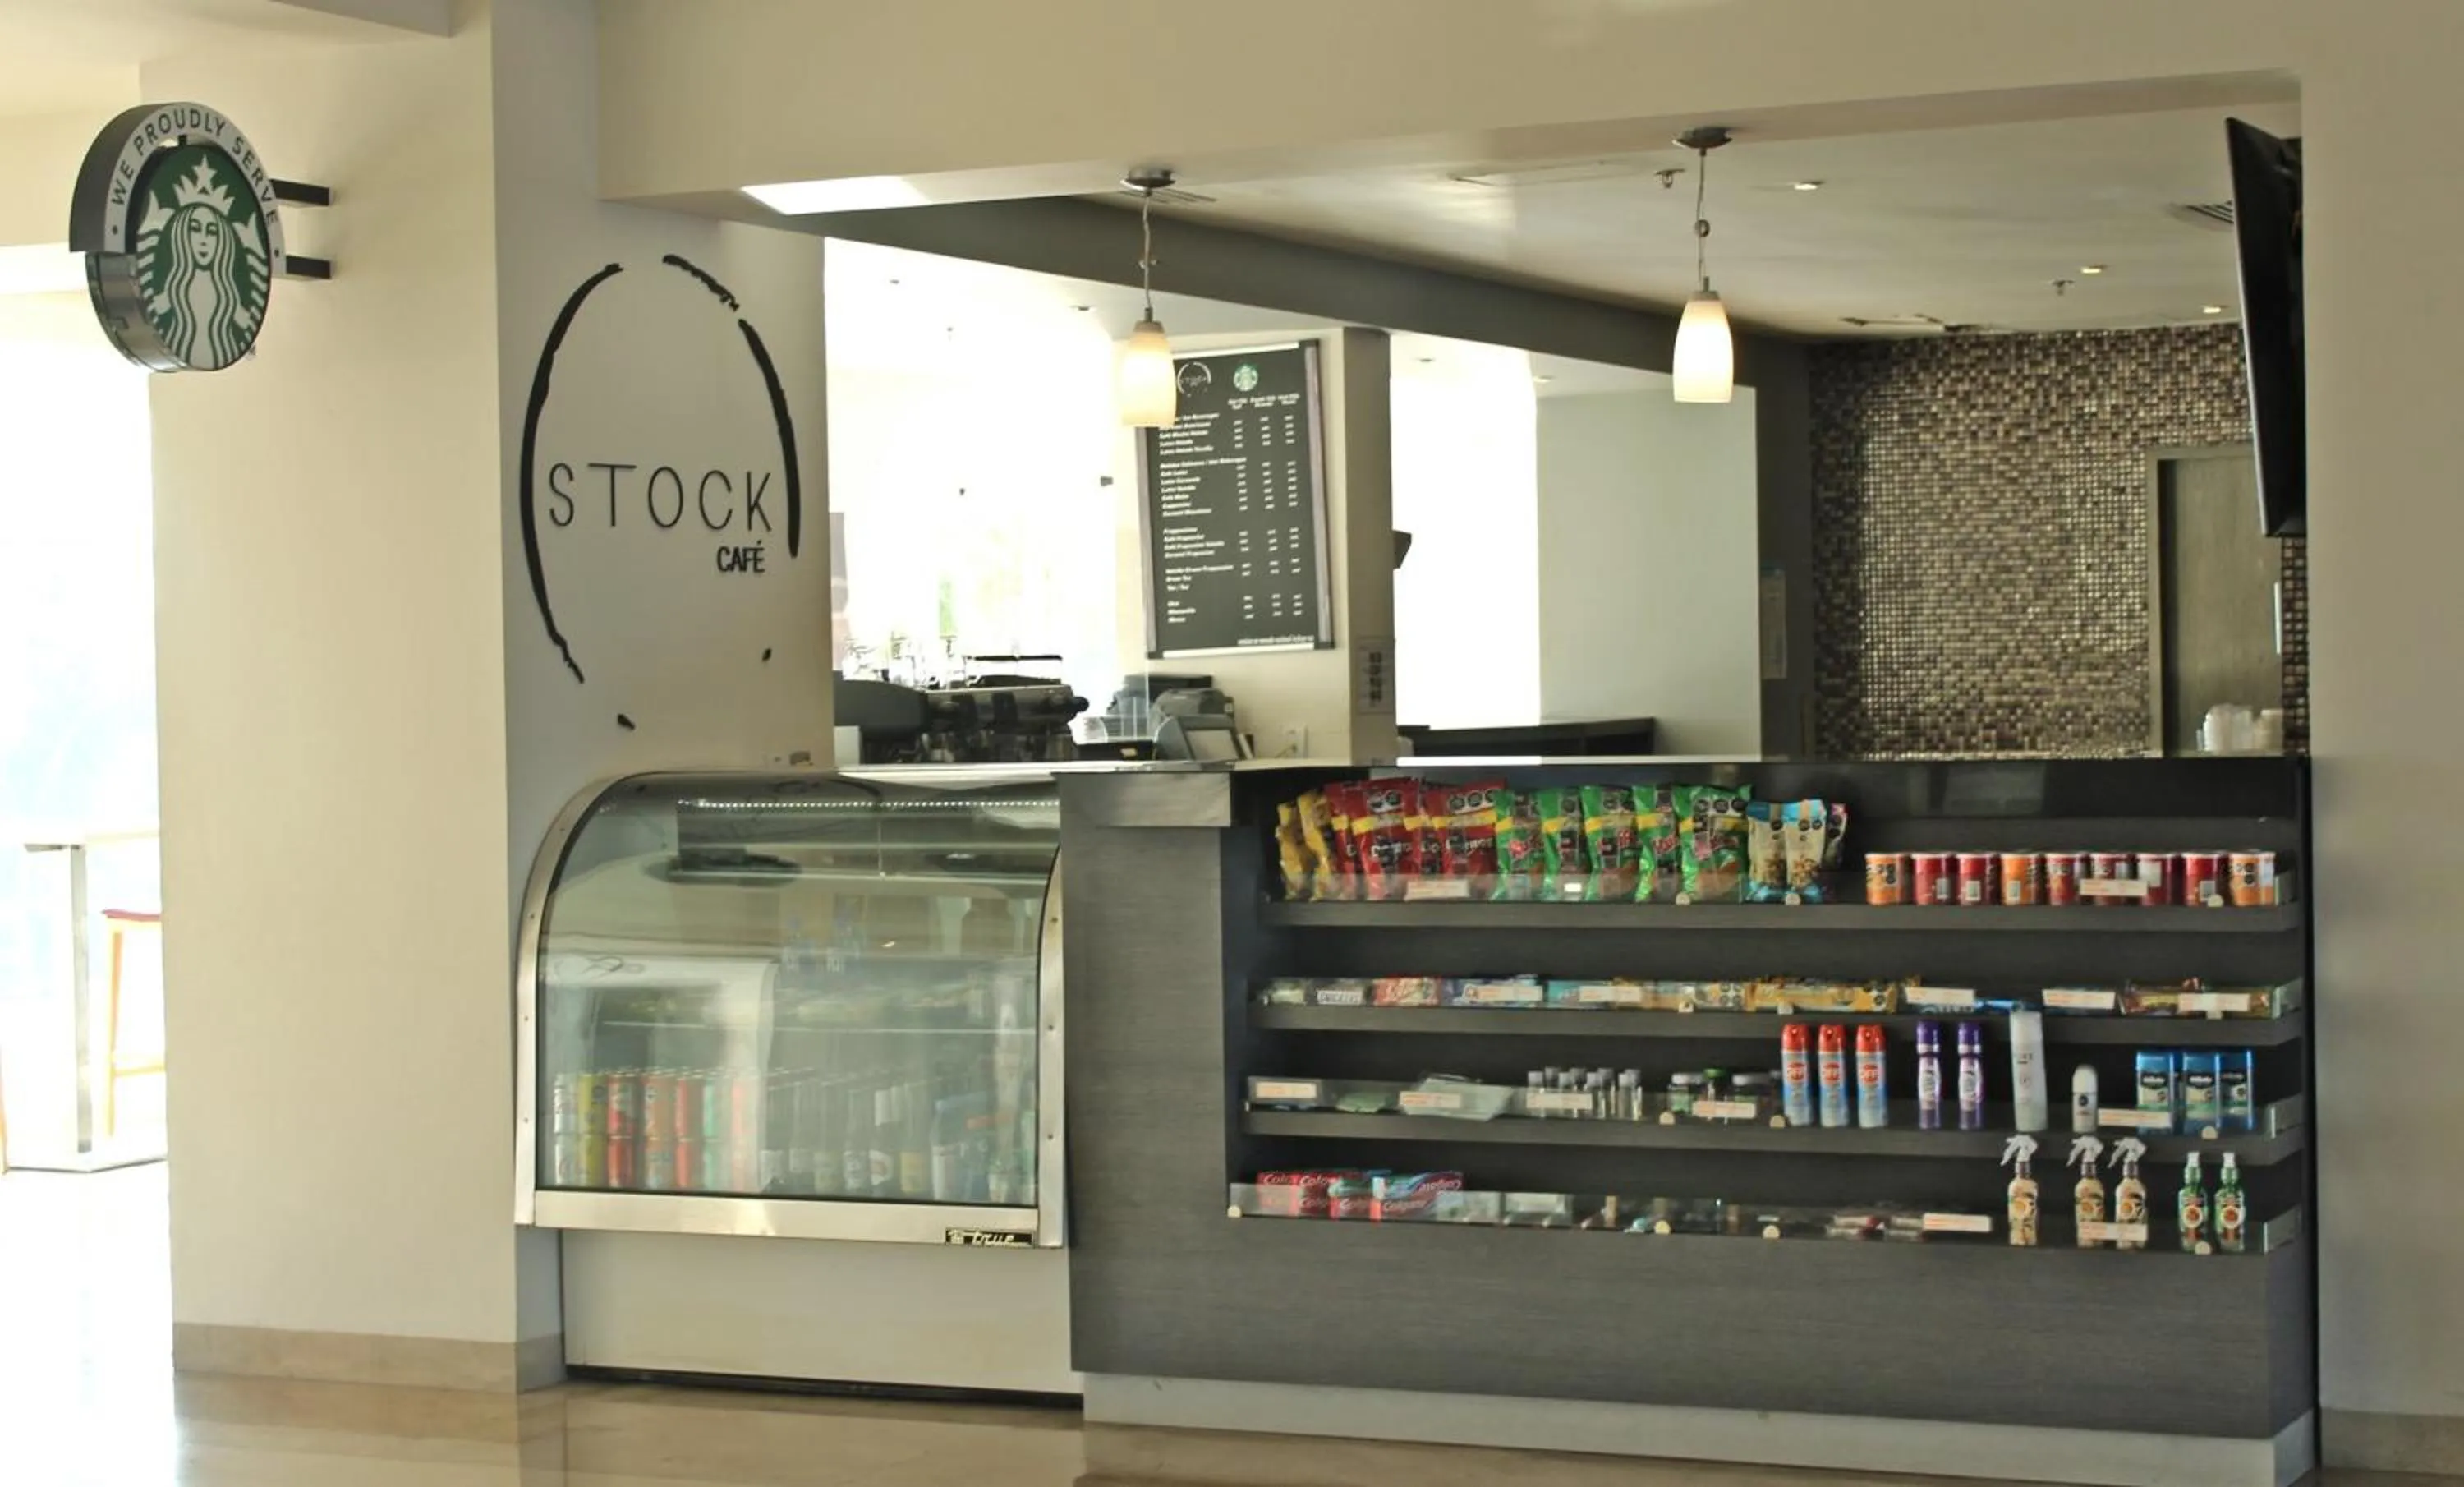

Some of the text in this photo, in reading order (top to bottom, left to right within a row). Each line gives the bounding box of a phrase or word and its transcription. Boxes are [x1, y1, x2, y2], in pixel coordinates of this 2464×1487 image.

[111, 108, 278, 226] WE PROUDLY SERVE
[549, 463, 771, 532] STOCK
[716, 540, 765, 573] CAFÉ
[972, 1231, 1015, 1245] true
